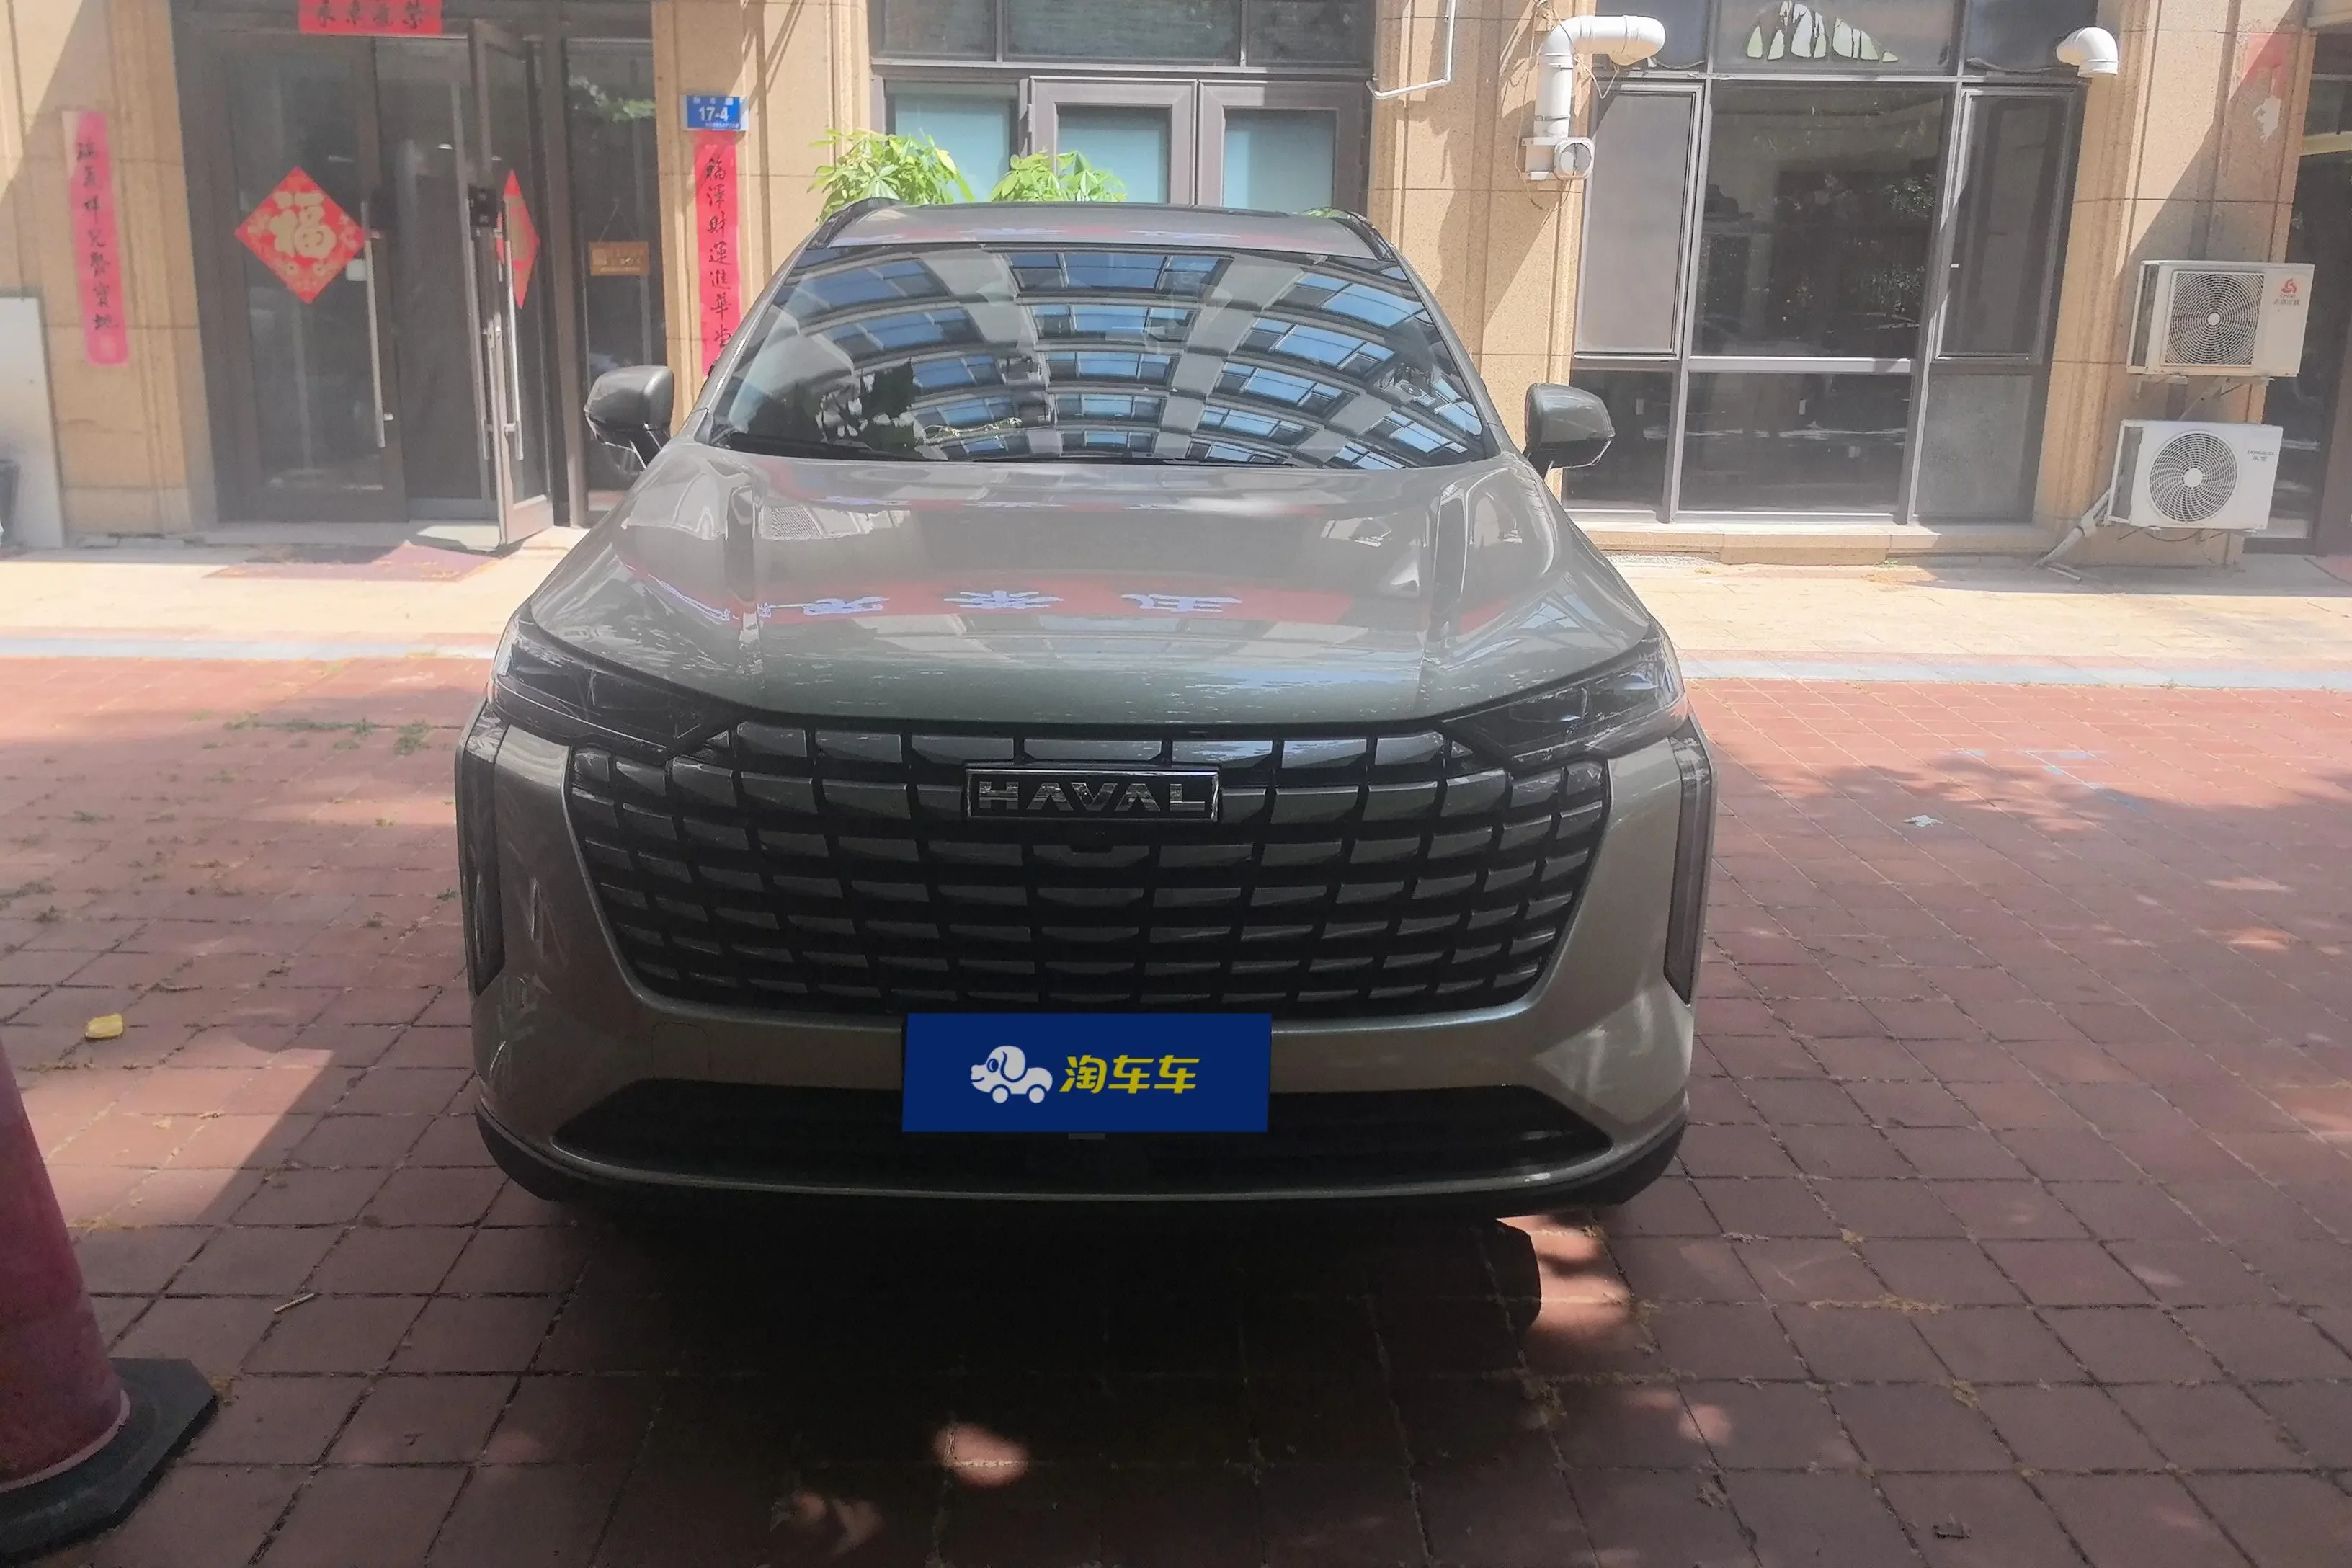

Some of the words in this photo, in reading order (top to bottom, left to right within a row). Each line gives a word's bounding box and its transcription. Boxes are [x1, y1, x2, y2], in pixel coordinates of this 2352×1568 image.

[698, 106, 729, 122] 17-4
[269, 190, 337, 259] 福
[979, 781, 1205, 811] HAVAL
